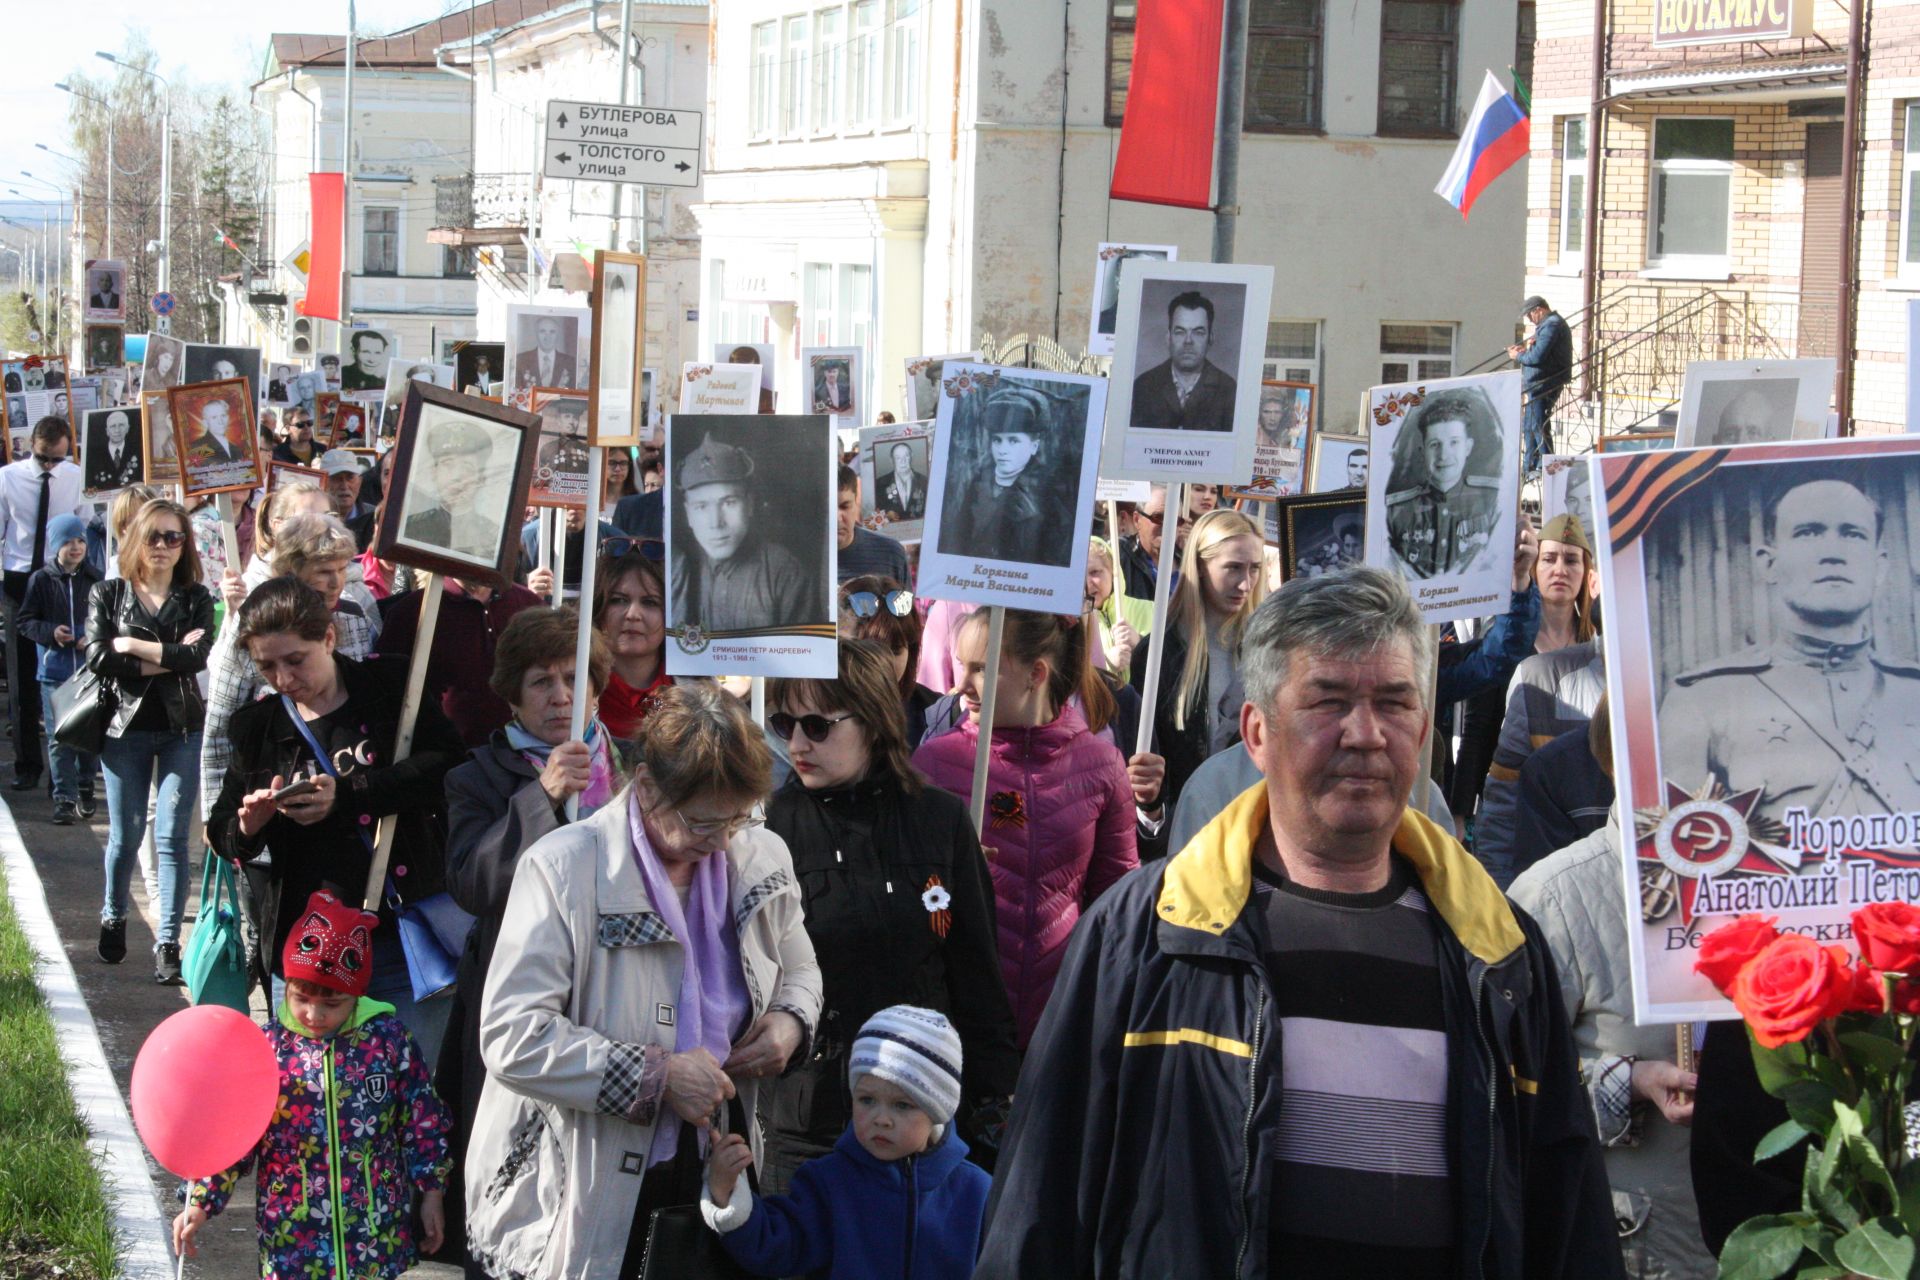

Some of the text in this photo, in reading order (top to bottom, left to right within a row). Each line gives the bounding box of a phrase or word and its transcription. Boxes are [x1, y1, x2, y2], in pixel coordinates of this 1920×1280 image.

[1659, 0, 1785, 34] НОТАРИУС
[579, 106, 677, 126] БУТЛЕРОВА
[580, 124, 628, 139] улица
[578, 144, 666, 162] ТОЛСТОГО
[578, 162, 626, 176] улица
[1144, 447, 1210, 457] ГУМЕРОВ АХМЕТ
[973, 564, 1029, 580] Корягина
[945, 575, 1054, 596] Мария Васильевна
[1418, 585, 1459, 599] Корягин
[712, 646, 812, 655] ЕРМИШИН ПЕТР АНДРЕЕВИЧ
[1693, 868, 1838, 911] Анатолий
